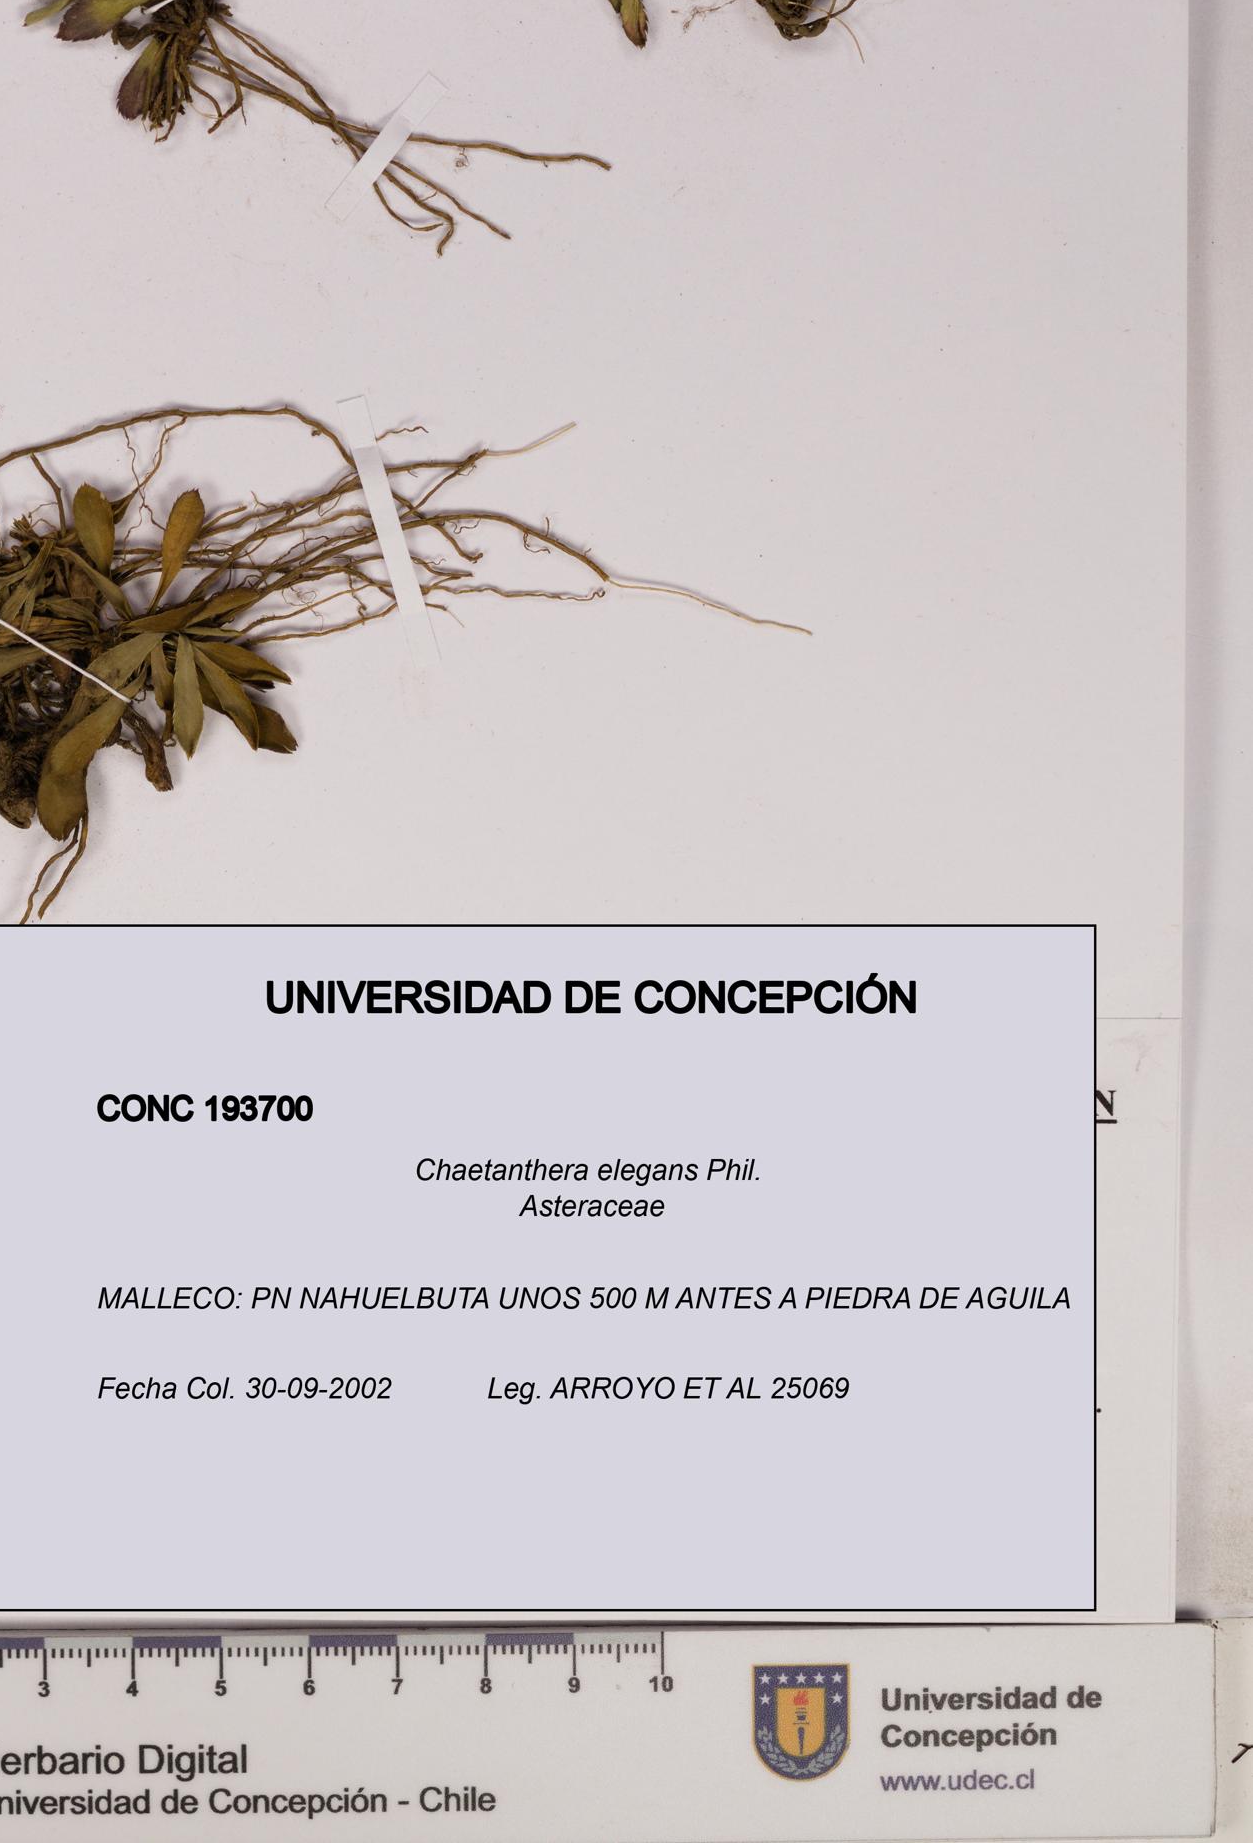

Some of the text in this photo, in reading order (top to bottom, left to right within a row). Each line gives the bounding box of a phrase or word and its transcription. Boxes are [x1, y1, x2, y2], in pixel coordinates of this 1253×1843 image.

[38, 1681, 50, 1697] 3
[126, 1681, 139, 1697] 4
[215, 1680, 227, 1696] 5
[303, 1680, 315, 1696] 6
[391, 1679, 403, 1695] 7
[480, 1678, 492, 1694] 8
[568, 1677, 580, 1693] 9
[649, 1676, 673, 1692] 10
[882, 1685, 1102, 1713] Universidad de
[881, 1722, 1056, 1752] Concepción
[139, 1744, 247, 1782] Digital
[880, 1769, 1034, 1791] www.udec.cl
[161, 1789, 198, 1814] de
[209, 1787, 387, 1819] Concepción
[420, 1786, 496, 1812] Chile
